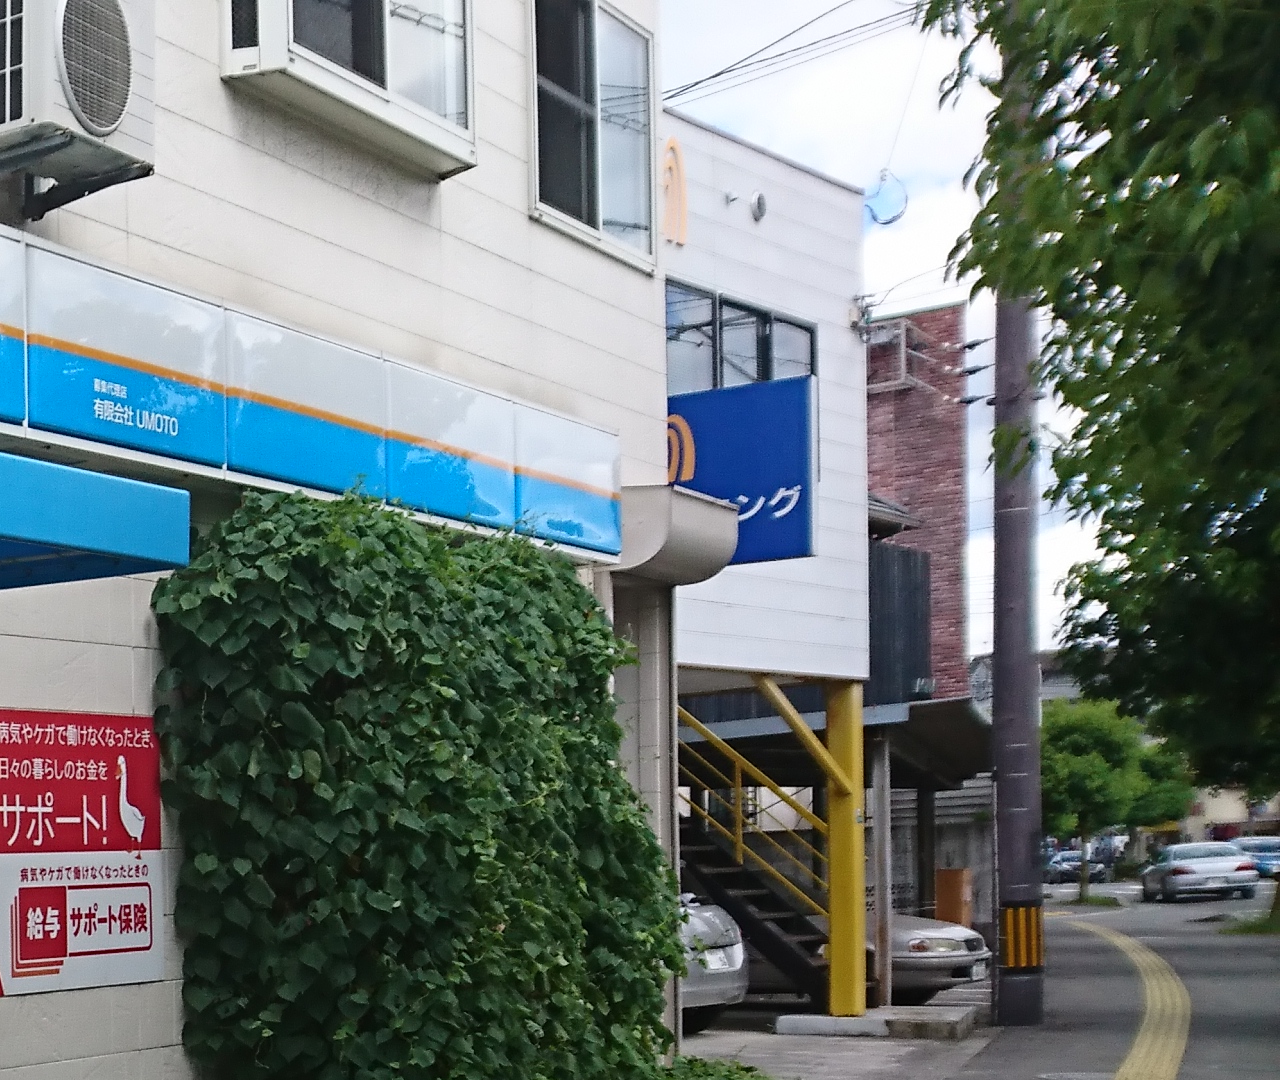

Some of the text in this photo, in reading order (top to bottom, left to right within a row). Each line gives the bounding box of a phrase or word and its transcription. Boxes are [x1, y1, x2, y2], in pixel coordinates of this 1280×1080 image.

[93, 398, 179, 436] 有限会社 UMOTO
[725, 484, 802, 522] ング
[20, 865, 148, 882] 病気やケガで働けなくなったときの
[26, 903, 148, 940] 給与 サポート保険
